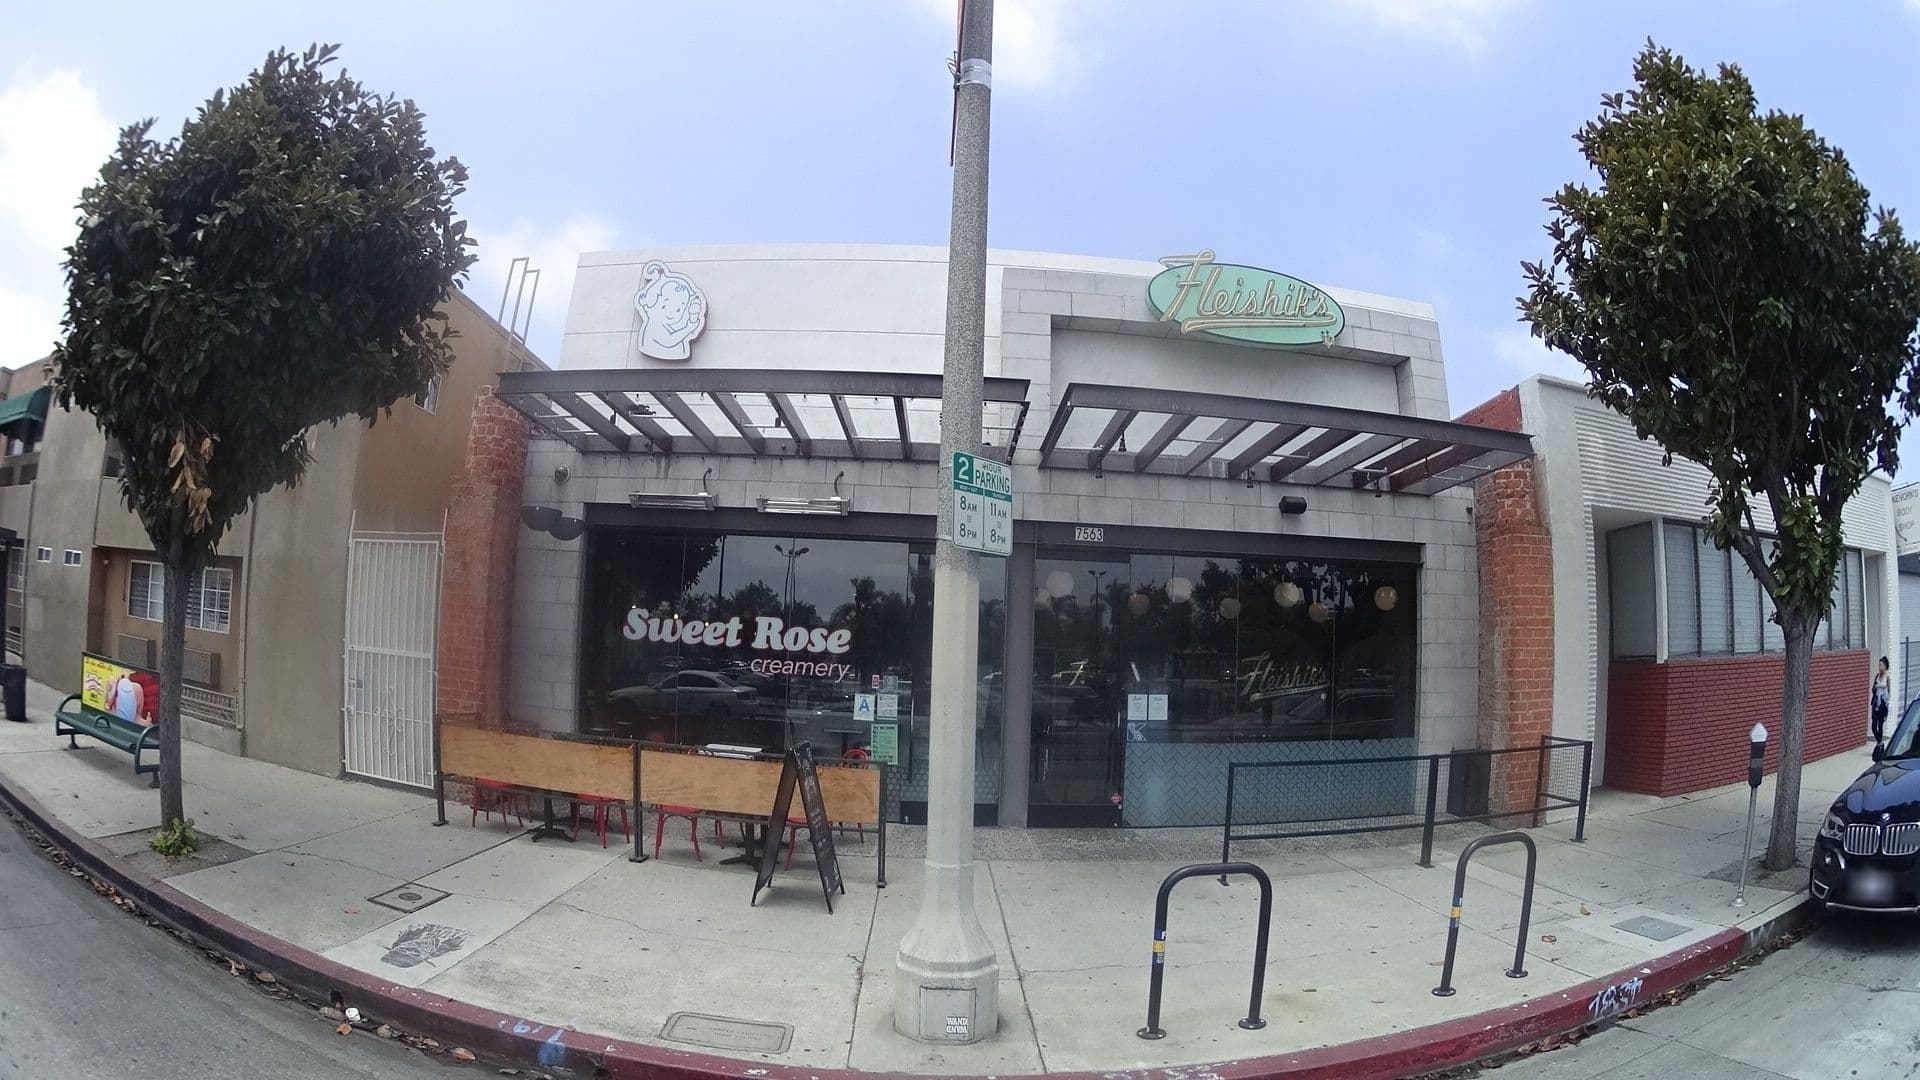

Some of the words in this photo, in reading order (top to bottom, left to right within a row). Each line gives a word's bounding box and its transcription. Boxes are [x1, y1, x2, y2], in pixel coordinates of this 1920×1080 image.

[958, 456, 969, 480] 2
[975, 469, 1010, 494] PARKING
[1076, 527, 1103, 541] 7563
[623, 607, 743, 648] Sweet
[751, 616, 851, 654] Rose
[750, 657, 850, 683] creamery
[858, 698, 870, 712] A
[946, 1017, 968, 1026] WAND
